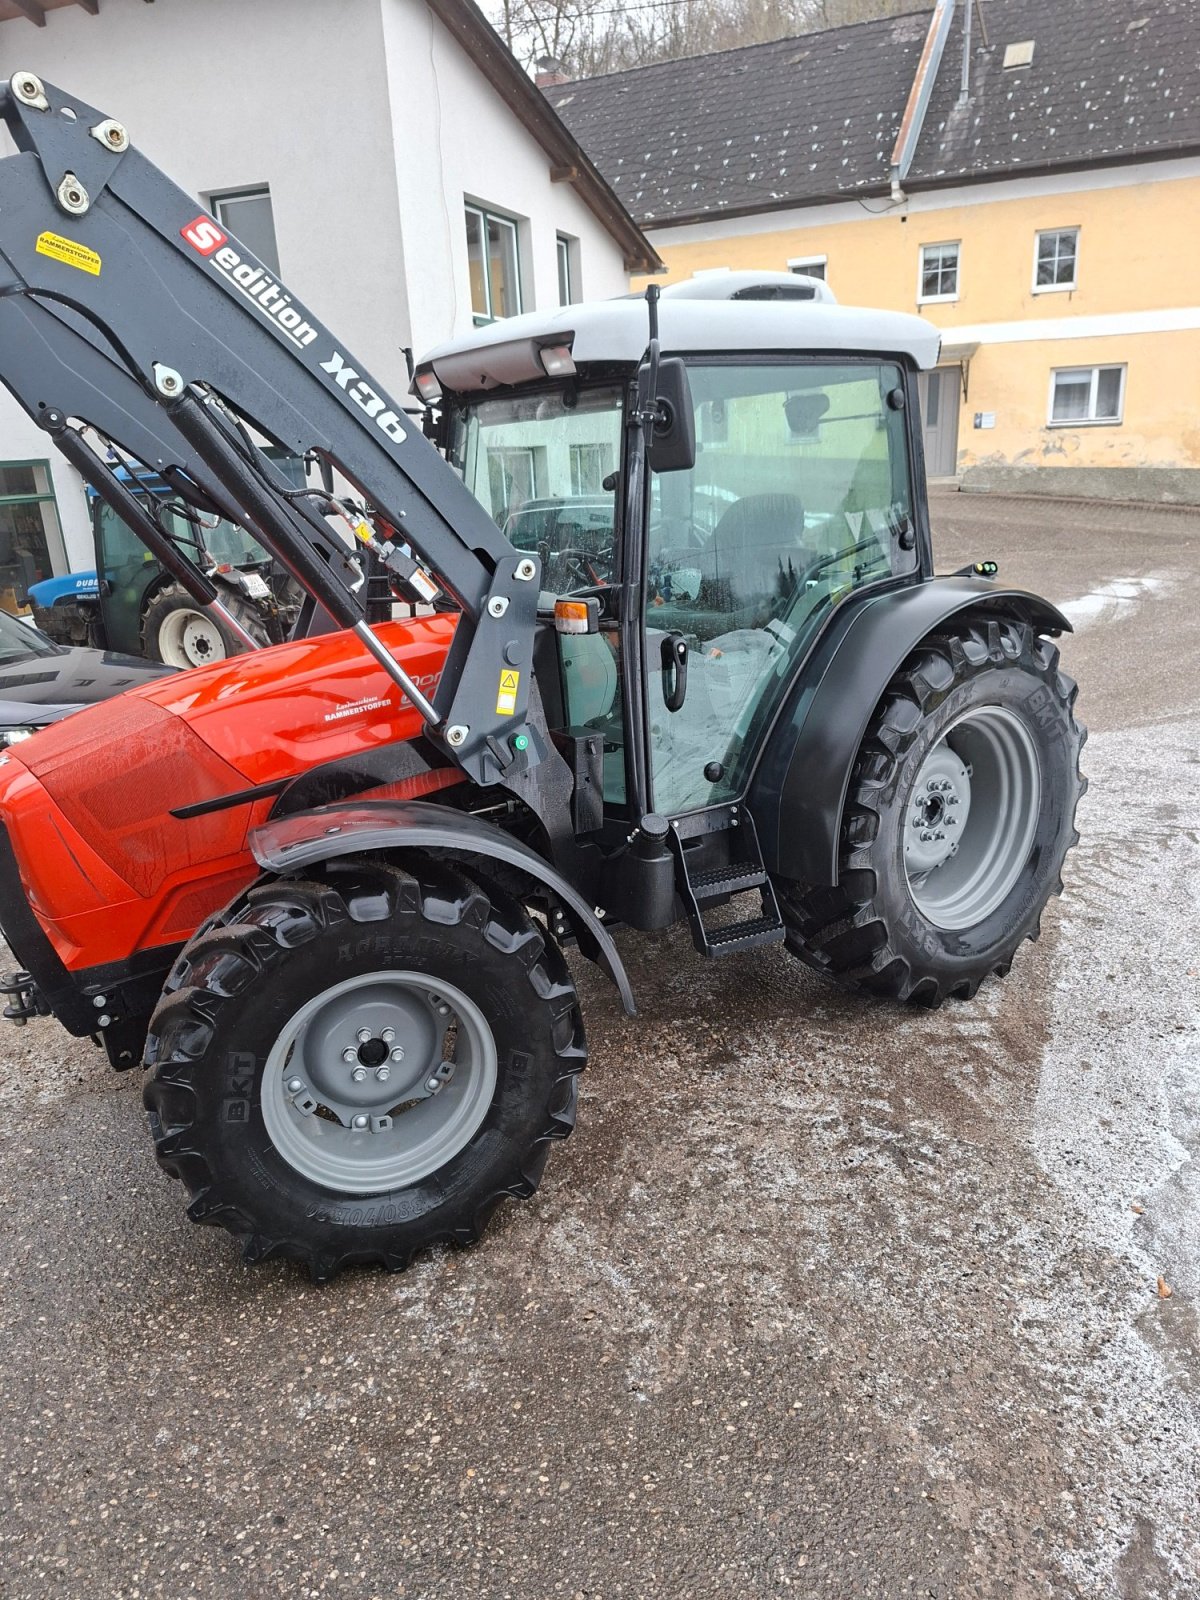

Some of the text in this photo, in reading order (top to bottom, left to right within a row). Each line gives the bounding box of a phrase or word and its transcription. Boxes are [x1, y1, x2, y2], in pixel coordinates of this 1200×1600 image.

[39, 236, 100, 265] RAMMERSTORFER
[214, 246, 319, 346] edition
[319, 350, 408, 444] X36
[324, 699, 392, 721] RAMMERSTORFER
[1021, 685, 1068, 740] BKT
[223, 1050, 256, 1123] BKT
